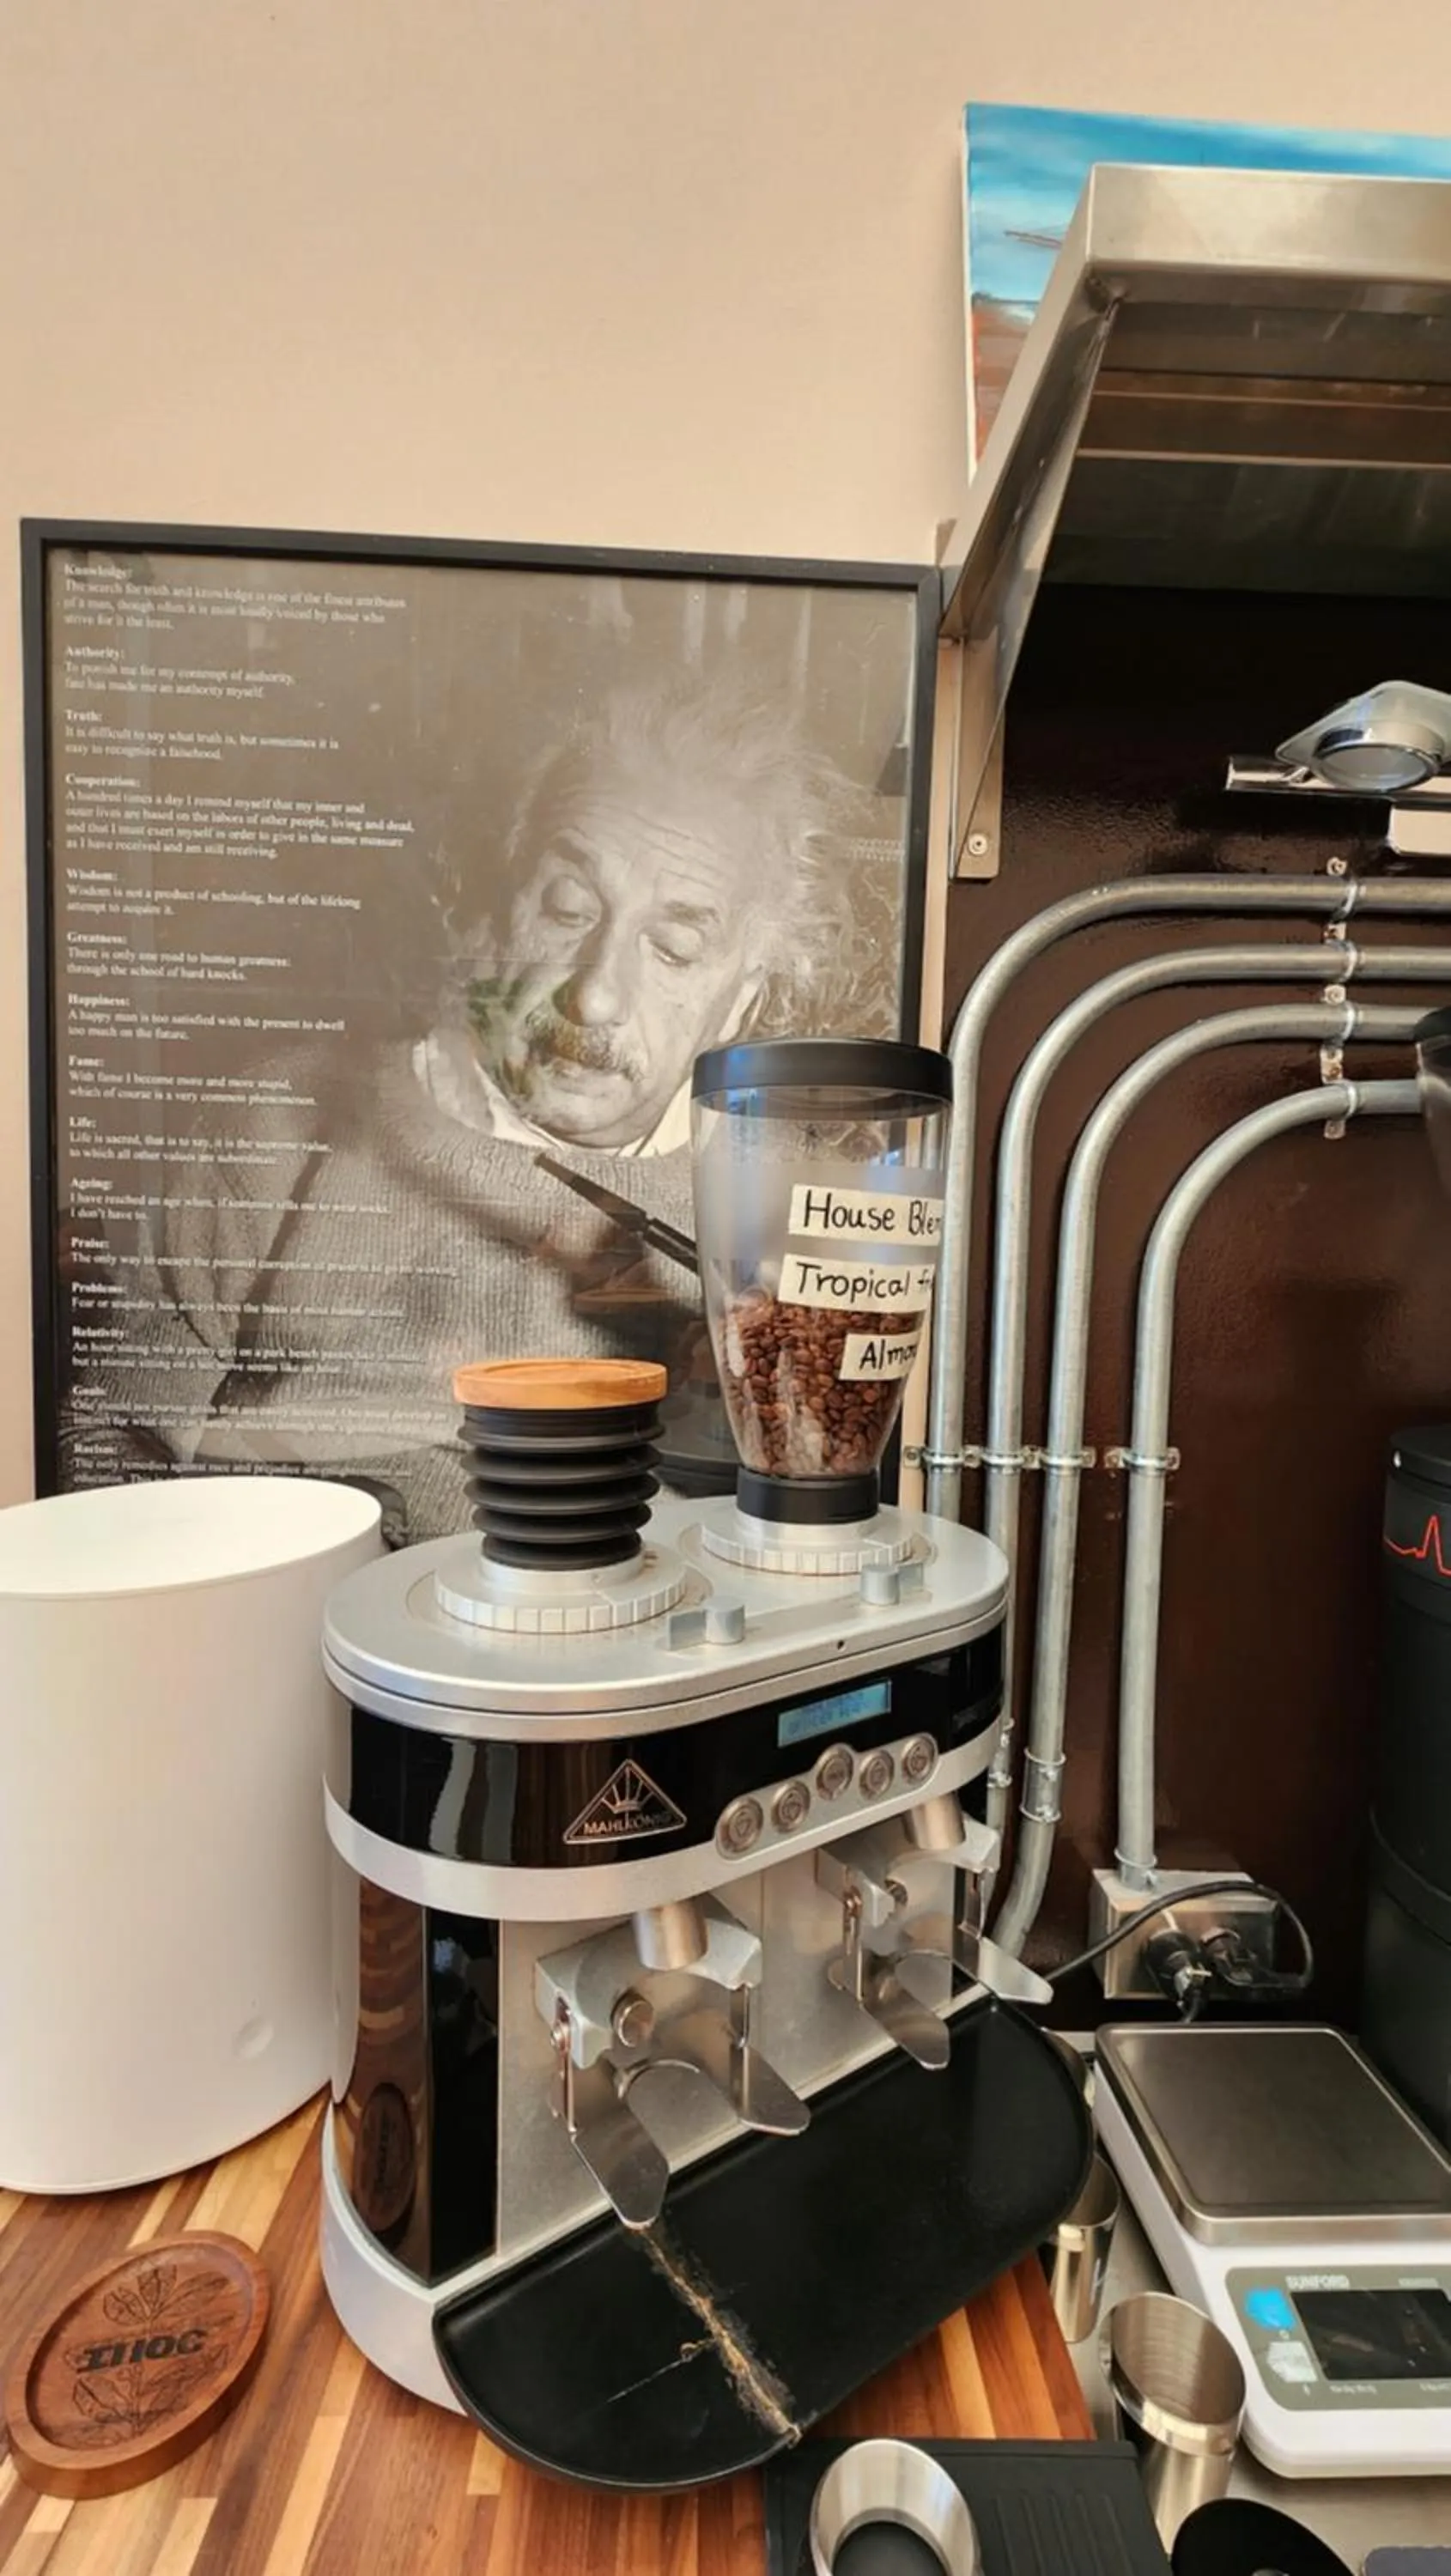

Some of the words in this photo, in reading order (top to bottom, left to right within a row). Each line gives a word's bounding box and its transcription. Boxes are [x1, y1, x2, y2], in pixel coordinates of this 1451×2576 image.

[64, 708, 102, 722] Truth:
[804, 1190, 896, 1230] House
[796, 1261, 910, 1303] Tropical
